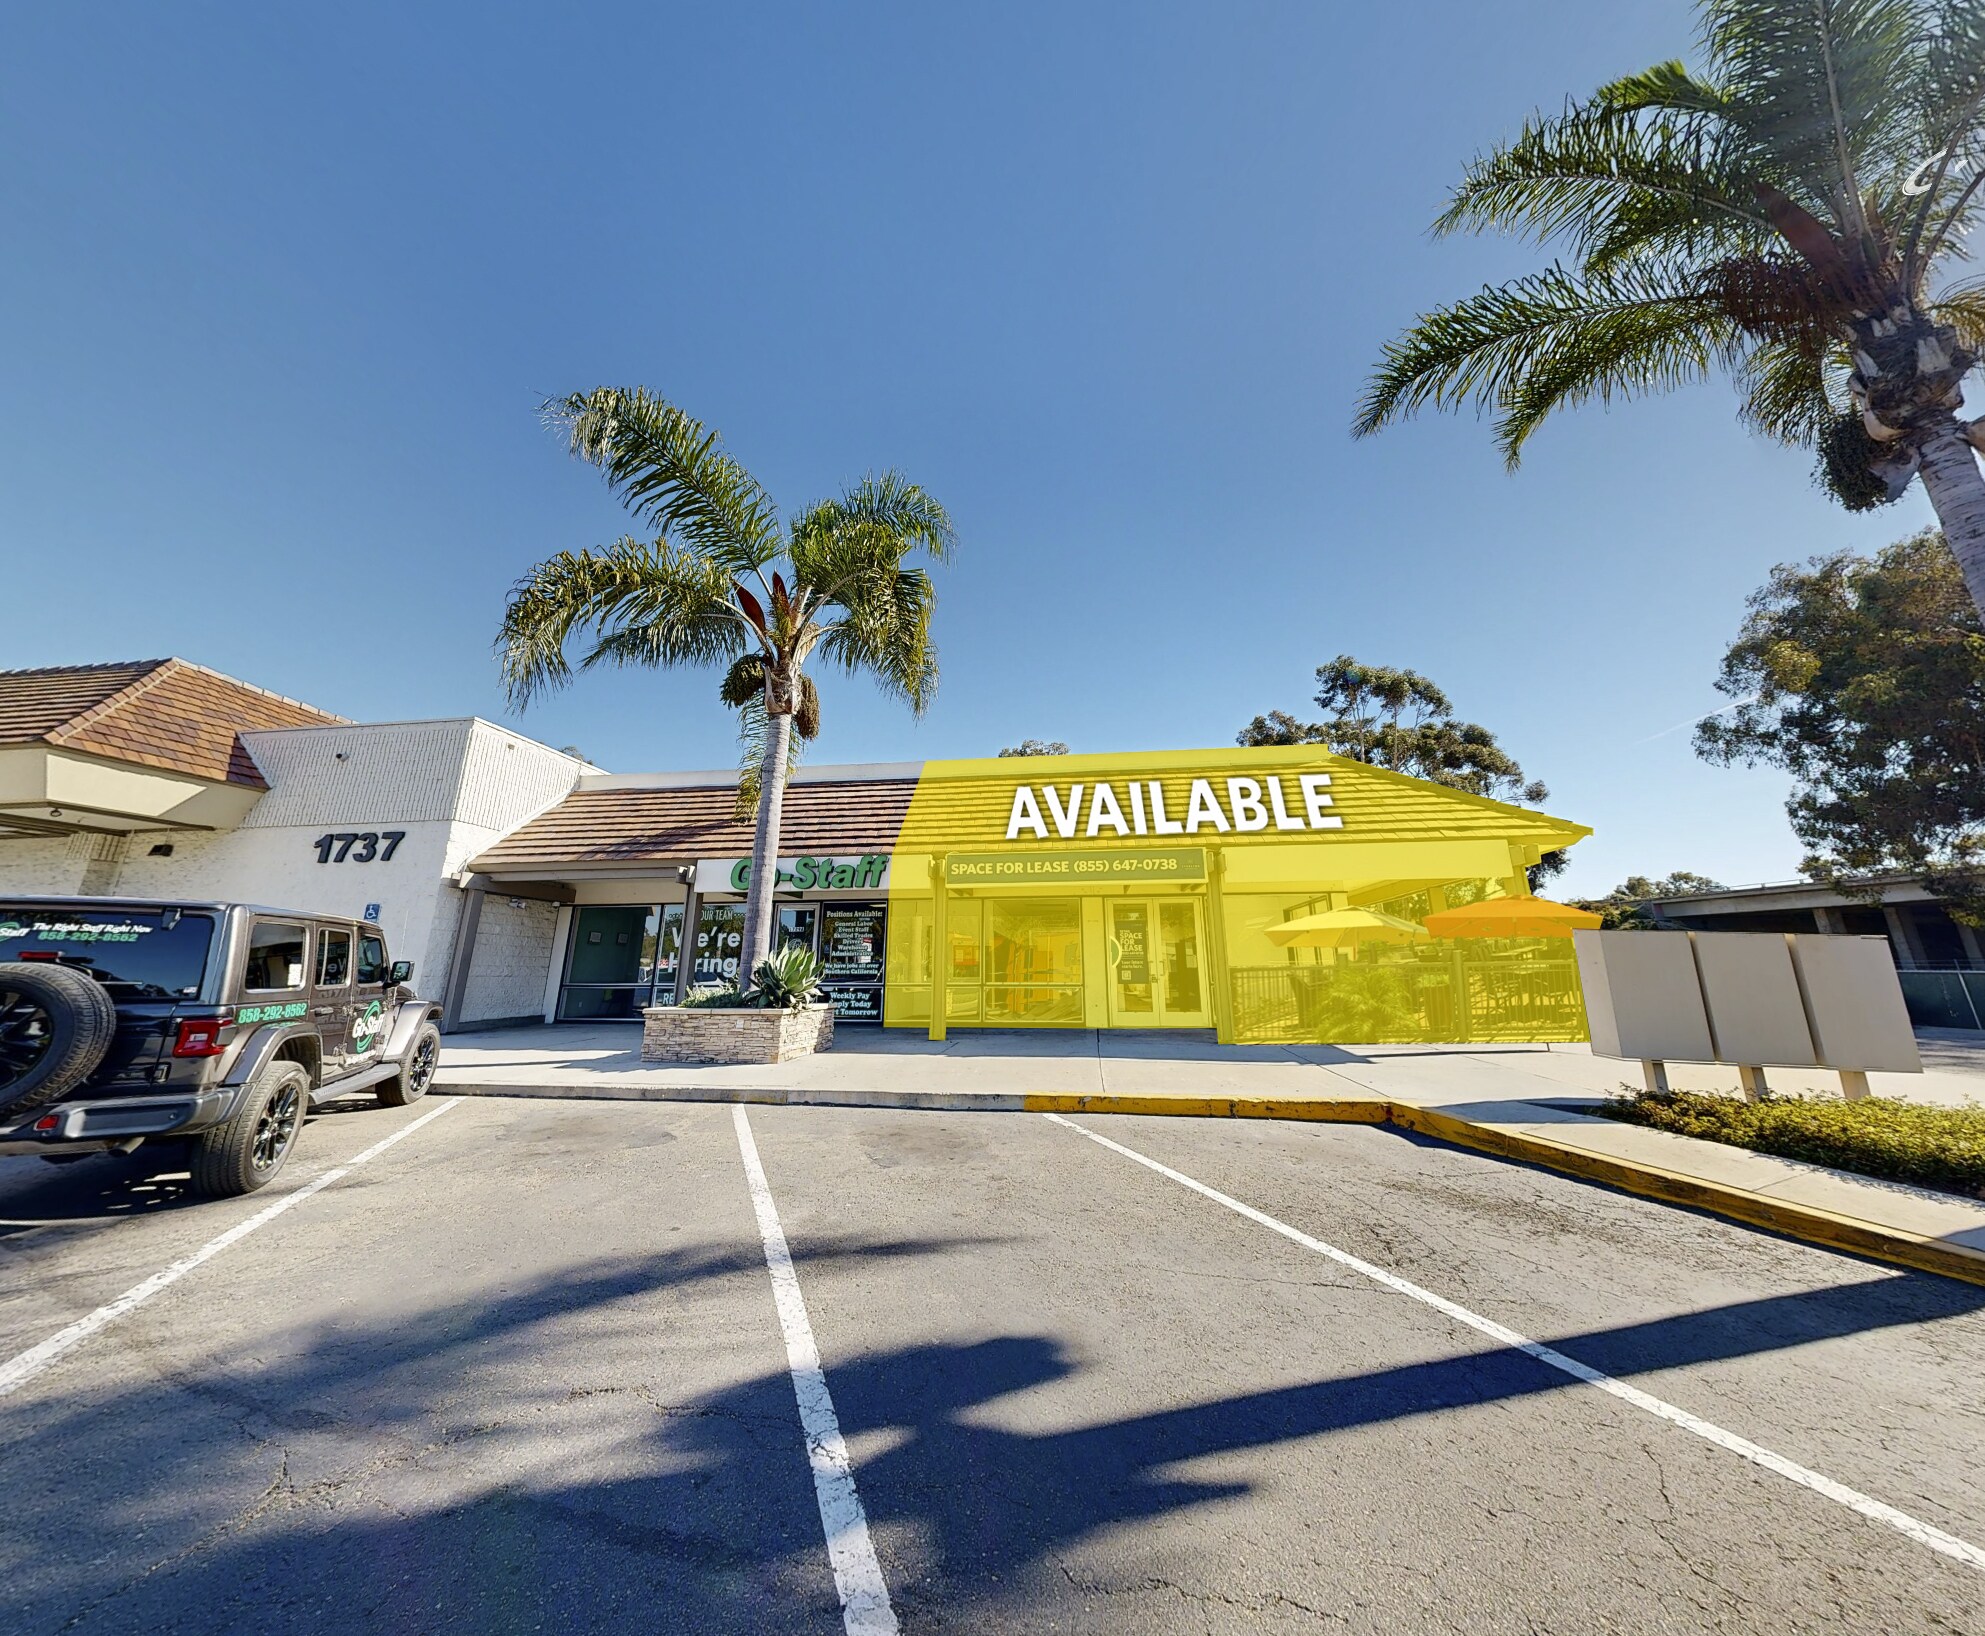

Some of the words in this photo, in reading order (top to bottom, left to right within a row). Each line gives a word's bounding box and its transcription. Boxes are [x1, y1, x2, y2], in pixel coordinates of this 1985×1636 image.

[314, 831, 406, 863] 1737
[730, 854, 889, 890] G-Staff
[951, 863, 993, 875] SPACE
[996, 862, 1024, 874] FOR
[1027, 861, 1069, 873] LEASE
[1073, 859, 1109, 873] (855)
[1112, 858, 1178, 871] 647-0738
[716, 909, 733, 920] TEAM
[32, 922, 52, 931] The
[52, 922, 80, 932] Right
[104, 924, 131, 933] Right
[130, 925, 153, 933] Now
[667, 951, 738, 978] Hring
[829, 992, 856, 1000] Weekly
[857, 992, 870, 1000] Pay
[238, 1002, 307, 1024] 858-292-8562
